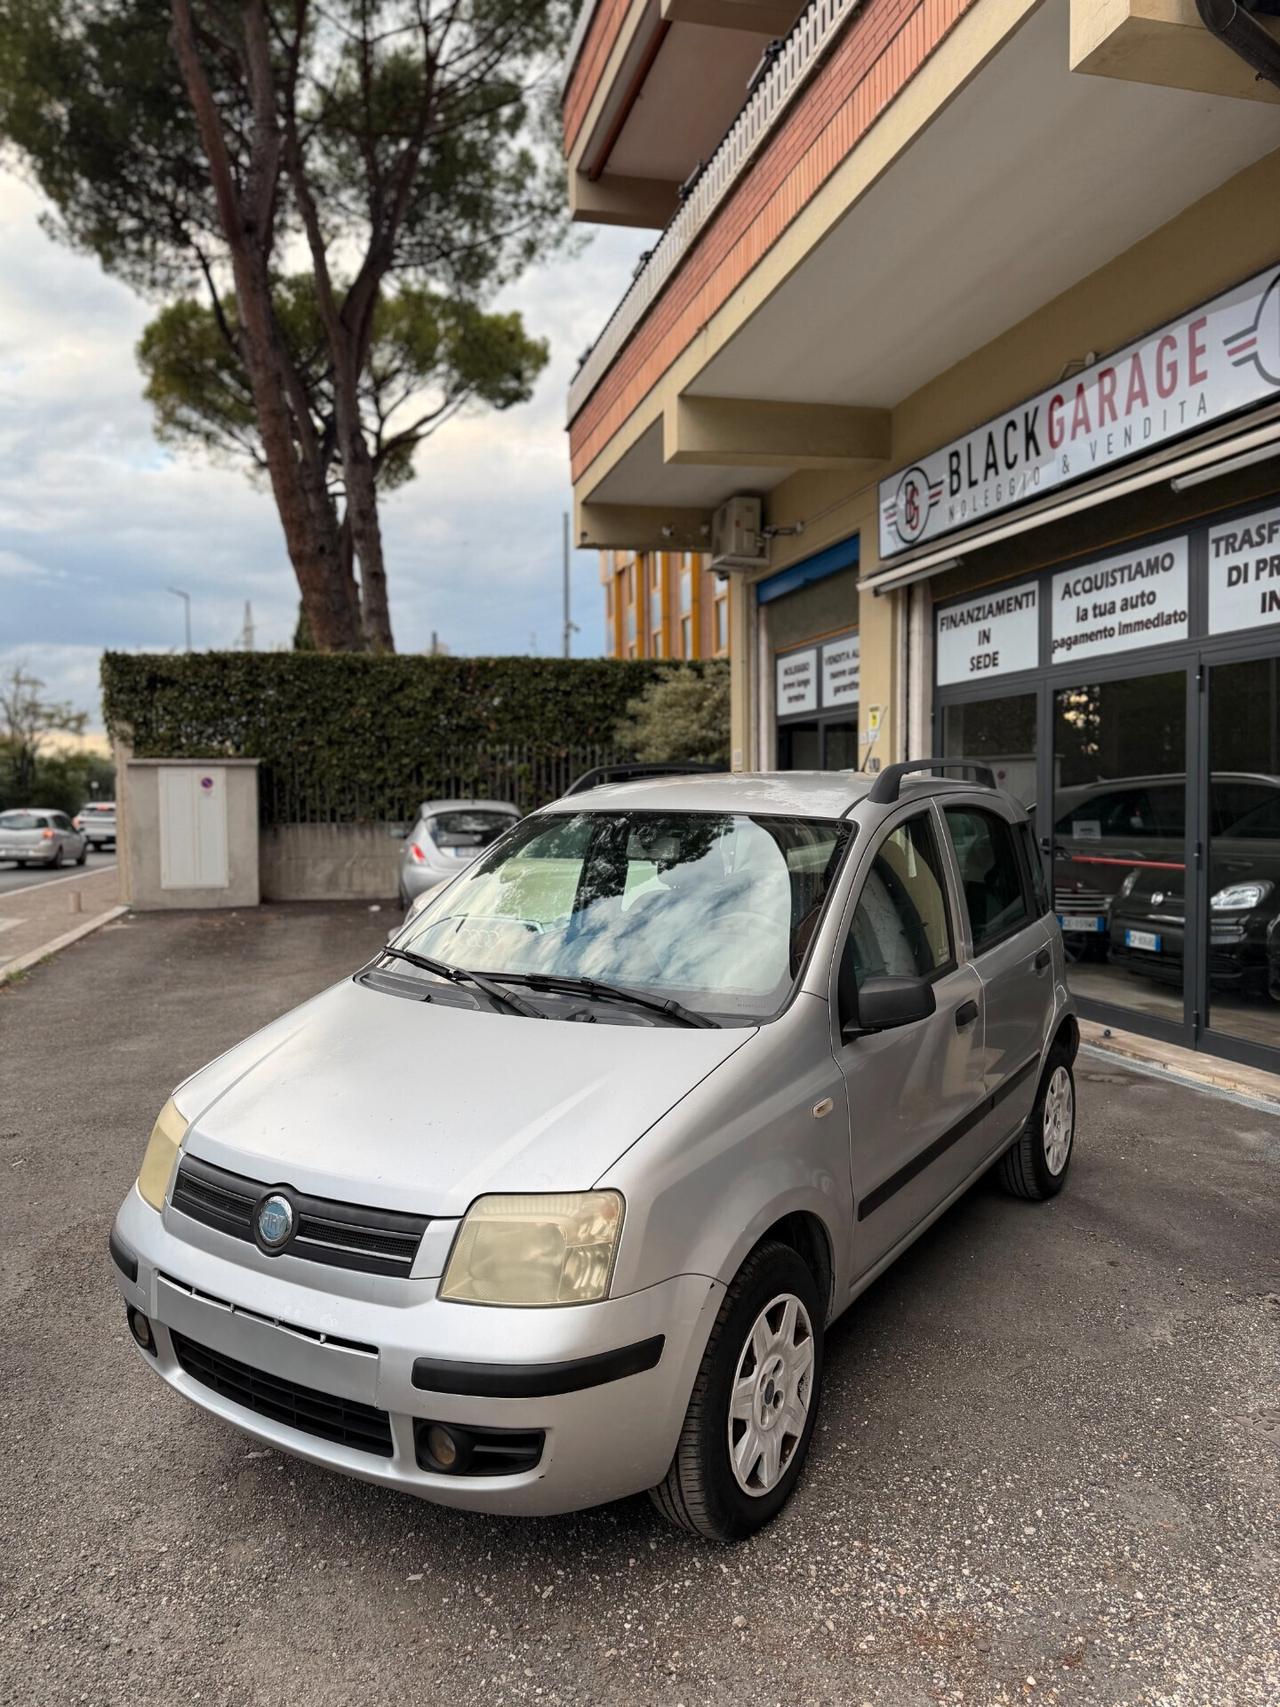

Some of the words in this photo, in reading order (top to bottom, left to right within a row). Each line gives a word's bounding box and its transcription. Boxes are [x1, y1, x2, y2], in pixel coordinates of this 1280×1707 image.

[948, 466, 1041, 524] NOLEGGIO
[1061, 453, 1071, 475] &
[1089, 391, 1208, 462] VENDITA
[1061, 551, 1175, 601] ACQUISTIAMO
[1227, 562, 1249, 587] DI
[939, 589, 1036, 633] FINANZIAMENTI
[1076, 604, 1089, 623] la
[1092, 599, 1116, 619] tua
[1120, 589, 1156, 611] auto
[978, 627, 991, 646] IN
[1052, 625, 1116, 654] pagamento
[1118, 609, 1187, 637] immediato
[969, 651, 999, 673] SEDE
